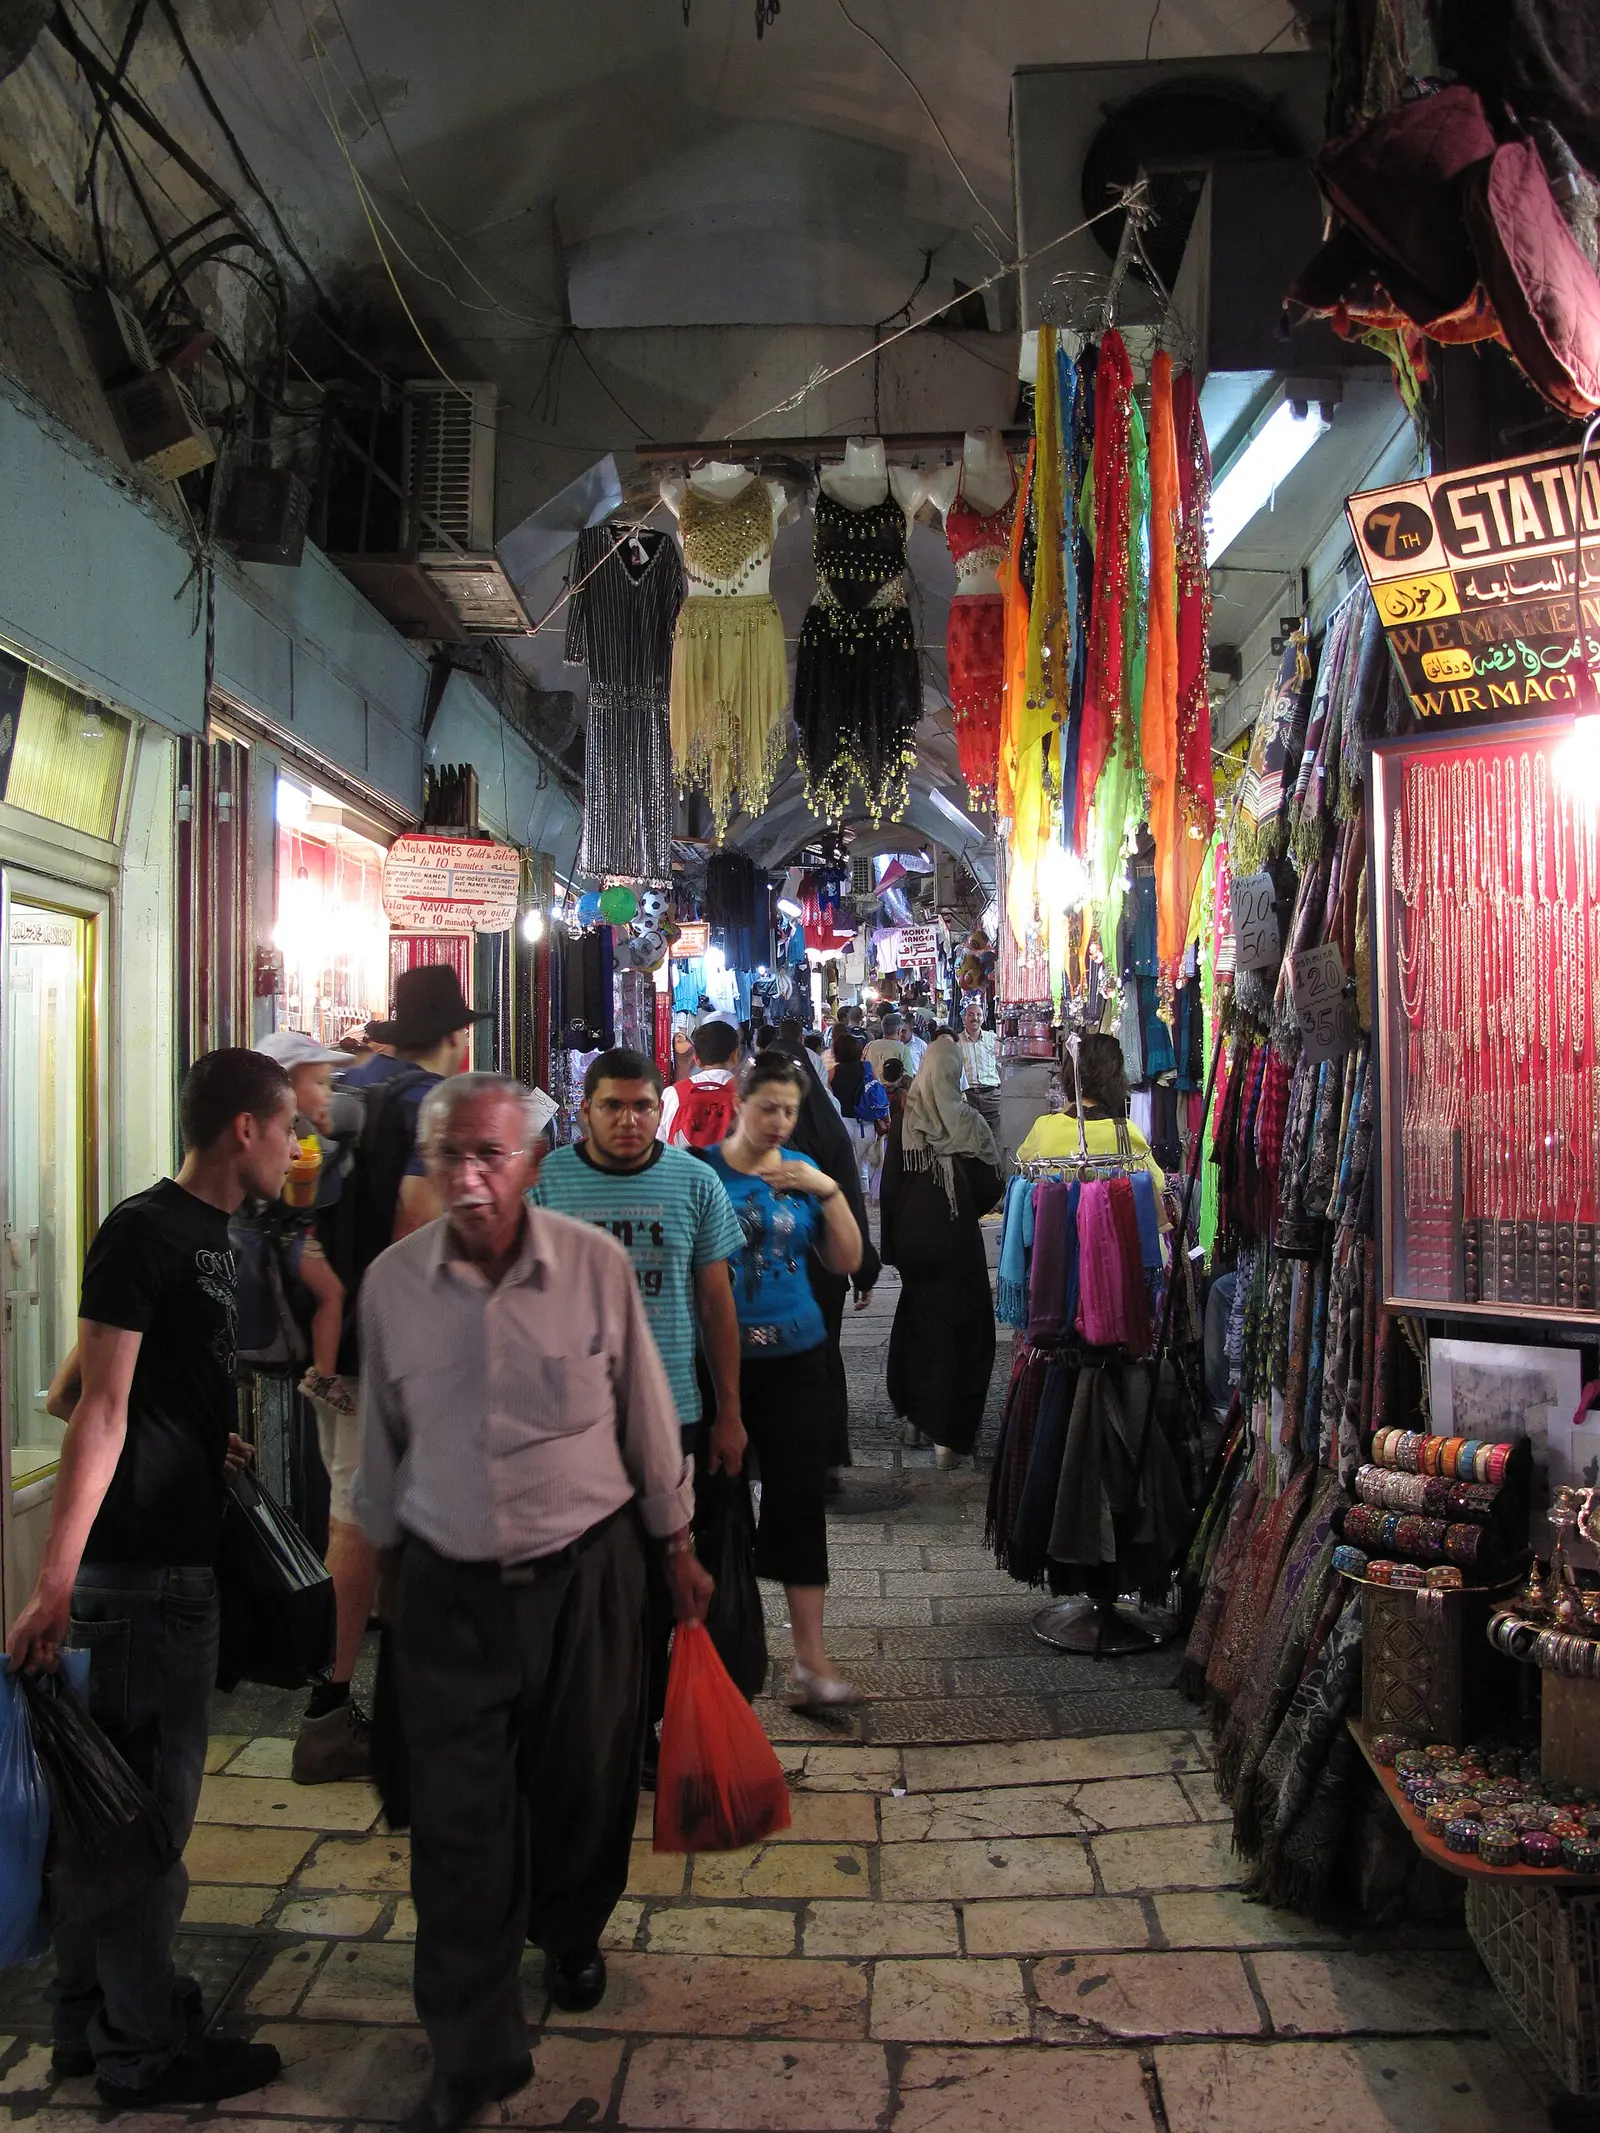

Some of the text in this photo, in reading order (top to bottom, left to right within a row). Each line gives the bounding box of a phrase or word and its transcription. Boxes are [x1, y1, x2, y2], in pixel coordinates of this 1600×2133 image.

[1446, 458, 1600, 555] STATIO
[1386, 621, 1454, 656] WE
[1458, 602, 1576, 645] MAKE
[1410, 687, 1488, 718] WIR
[401, 841, 427, 855] Make
[428, 844, 462, 857] NAMES
[466, 847, 487, 859] Gold
[492, 849, 520, 861] Silver
[435, 857, 449, 869] 10
[453, 860, 484, 870] minutes
[420, 902, 455, 914] NAVNE
[432, 914, 443, 925] 10
[901, 928, 930, 937] MONEY
[905, 958, 932, 966] ATM
